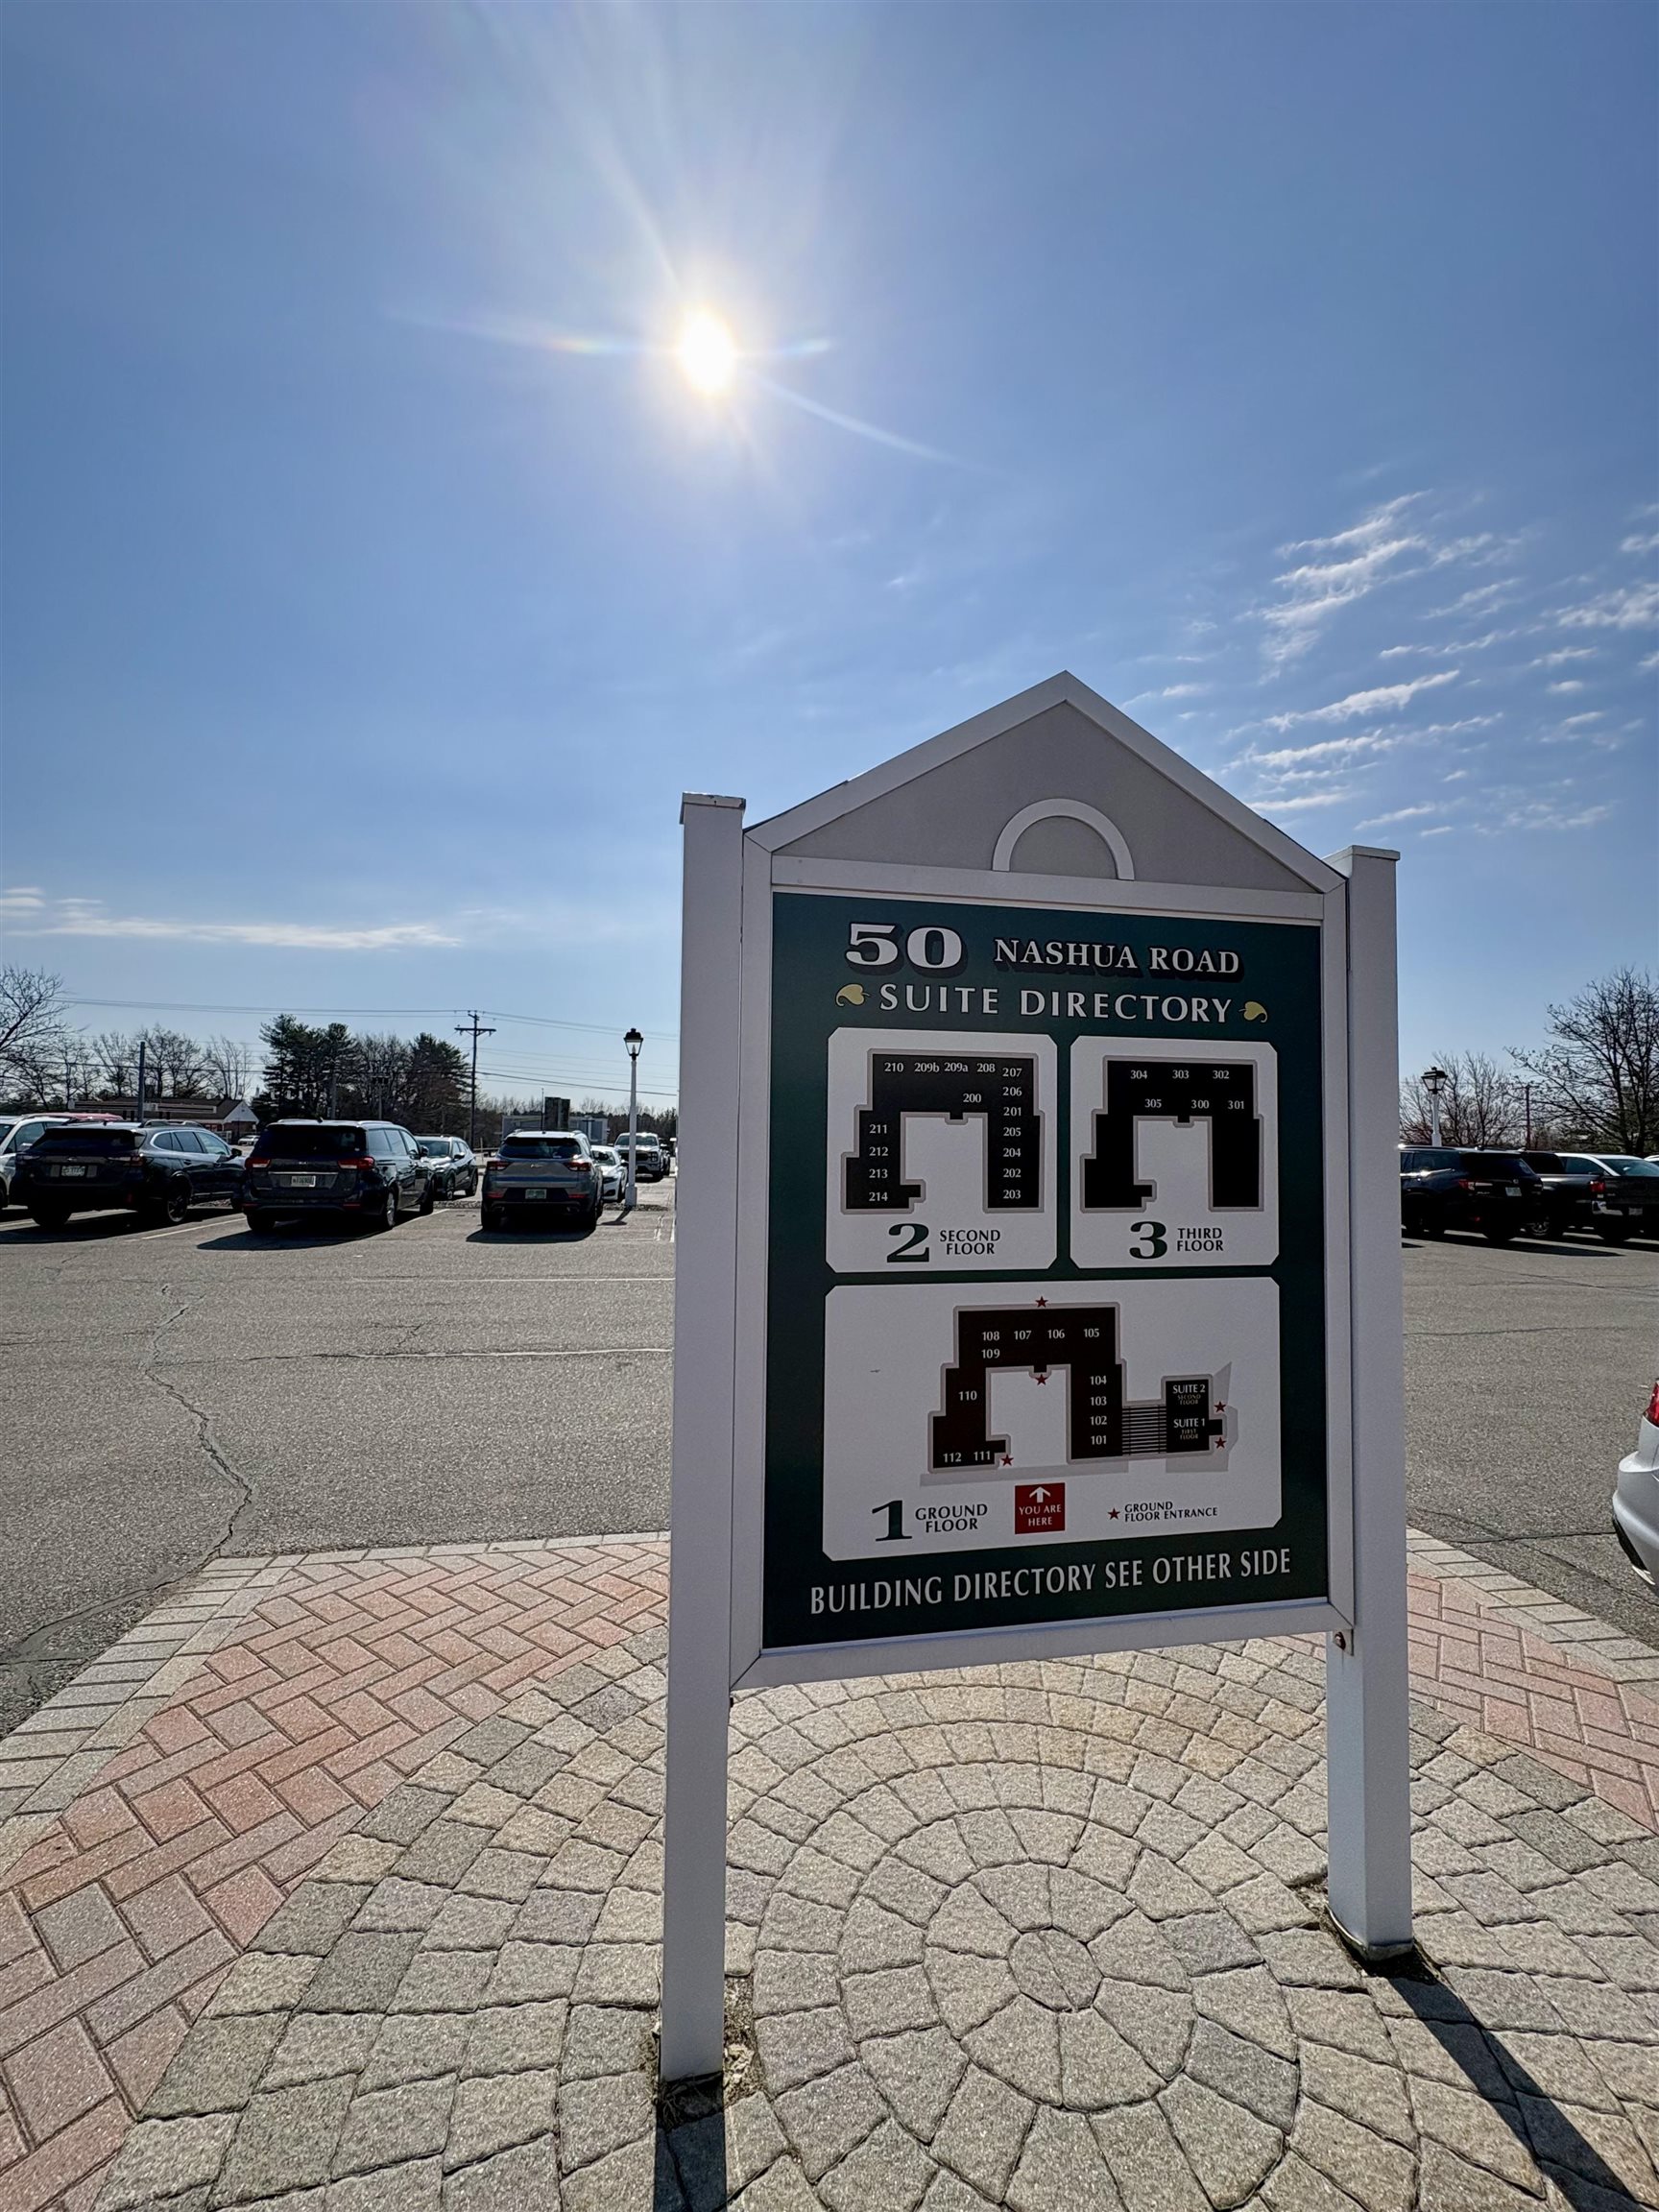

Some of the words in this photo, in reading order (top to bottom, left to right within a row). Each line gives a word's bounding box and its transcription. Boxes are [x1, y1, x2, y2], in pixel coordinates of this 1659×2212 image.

[847, 924, 961, 968] 50
[996, 940, 1137, 968] NASHUA
[1150, 948, 1238, 973] ROAD
[881, 984, 998, 1013] SUITE
[1022, 991, 1231, 1022] DIRECTORY
[884, 1062, 904, 1072] 210
[914, 1062, 940, 1073] 209b
[944, 1062, 969, 1072] 209a
[976, 1063, 996, 1073] 208
[1002, 1067, 1022, 1077] 207
[1130, 1070, 1148, 1080] 304
[1171, 1069, 1190, 1080] 303
[1213, 1070, 1230, 1080] 302
[1002, 1086, 1022, 1096] 206
[962, 1093, 982, 1103] 200
[1144, 1098, 1163, 1109] 305
[1190, 1099, 1210, 1109] 300
[1227, 1099, 1245, 1110] 301
[1003, 1106, 1022, 1117] 201
[869, 1123, 887, 1134] 211
[1002, 1126, 1022, 1137] 205
[869, 1146, 889, 1157] 212
[1002, 1147, 1022, 1158] 204
[869, 1168, 888, 1179] 213
[1002, 1167, 1022, 1178] 202
[868, 1191, 888, 1202] 214
[1002, 1189, 1022, 1199] 203
[939, 1229, 1001, 1242] SECOND
[1177, 1227, 1223, 1239] THIRD
[887, 1223, 929, 1262] 2
[1130, 1221, 1167, 1259] 3
[1176, 1239, 1224, 1252] FLOOR
[946, 1242, 995, 1256] FLOOR
[982, 1331, 1000, 1341] 108
[1014, 1330, 1032, 1340] 107
[1047, 1329, 1066, 1339] 106
[1083, 1328, 1100, 1338] 105
[981, 1348, 1000, 1359] 109
[1090, 1375, 1107, 1385] 104
[1172, 1383, 1198, 1394] SUITE
[1200, 1384, 1206, 1393] 2
[958, 1390, 977, 1402] 110
[1090, 1395, 1108, 1407] 103
[1090, 1415, 1108, 1426] 102
[1173, 1418, 1199, 1429] SUITE
[1201, 1418, 1205, 1427] 1
[1090, 1434, 1107, 1445] 101
[943, 1452, 962, 1463] 112
[974, 1450, 991, 1461] 111
[915, 1503, 988, 1521] GROUND
[1019, 1505, 1041, 1516] YOU
[1043, 1503, 1062, 1514] ARE
[1124, 1502, 1173, 1513] GROUND
[1124, 1510, 1161, 1523] FLOOR
[1164, 1506, 1217, 1520] ENTRANCE
[872, 1501, 912, 1541] 1
[926, 1515, 978, 1532] FLOOR
[1027, 1516, 1052, 1527] HERE
[811, 1576, 941, 1614] BUILDING
[954, 1564, 1095, 1600] DIRECTORY
[1106, 1560, 1142, 1588] SEE
[1153, 1553, 1231, 1583] OTHER
[1241, 1549, 1289, 1576] SIDE
